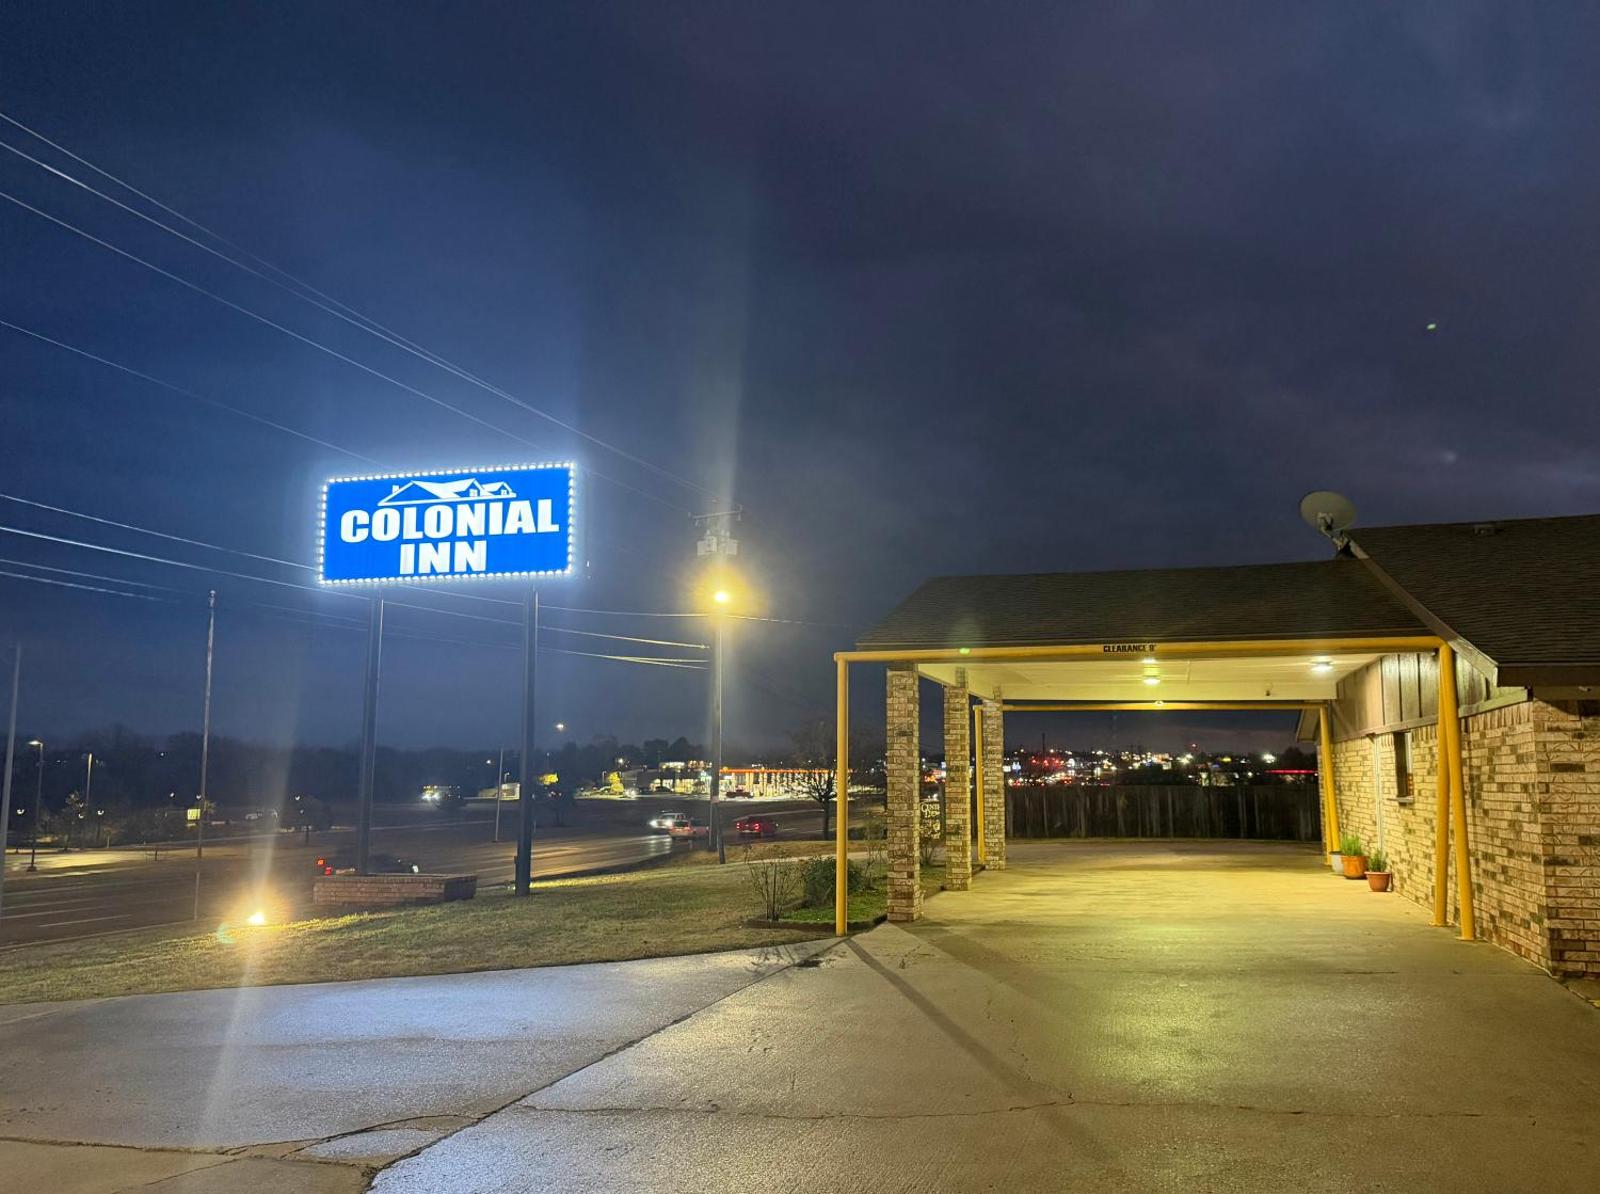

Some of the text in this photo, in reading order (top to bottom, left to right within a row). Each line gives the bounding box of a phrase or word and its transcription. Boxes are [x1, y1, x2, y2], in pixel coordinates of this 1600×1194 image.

[340, 498, 560, 543] COLONIAL
[399, 540, 488, 575] INN
[1103, 644, 1147, 653] CLEARANCE
